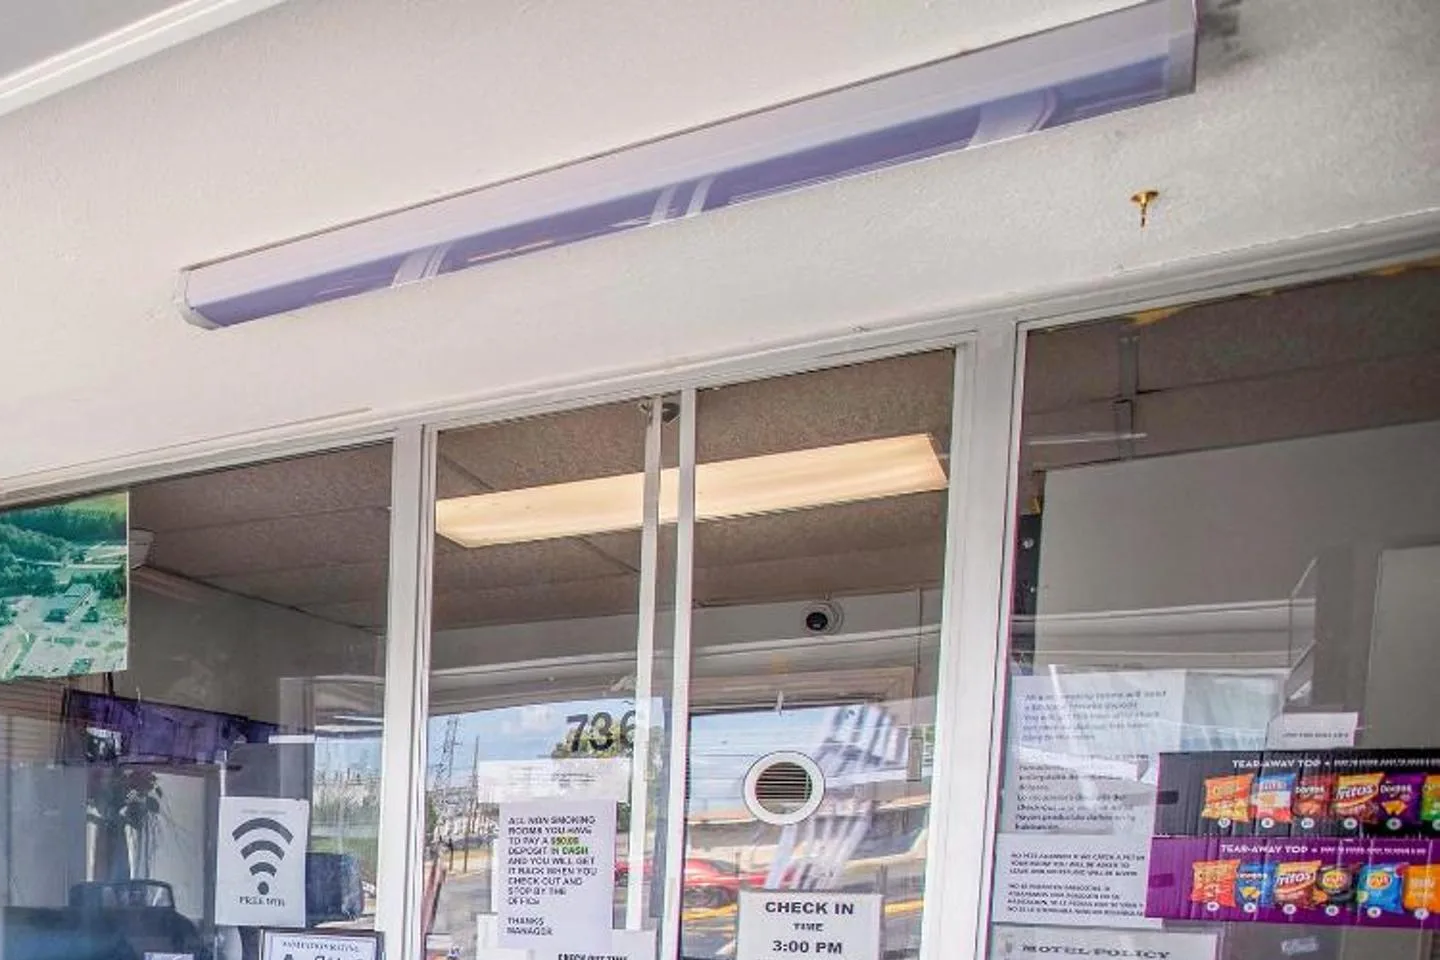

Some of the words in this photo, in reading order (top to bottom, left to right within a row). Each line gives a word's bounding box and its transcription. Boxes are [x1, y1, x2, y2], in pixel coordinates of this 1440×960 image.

[765, 902, 828, 914] CHECK
[834, 903, 855, 915] IN
[793, 923, 824, 932] TIME
[772, 940, 810, 953] 3:00
[815, 942, 843, 954] PM
